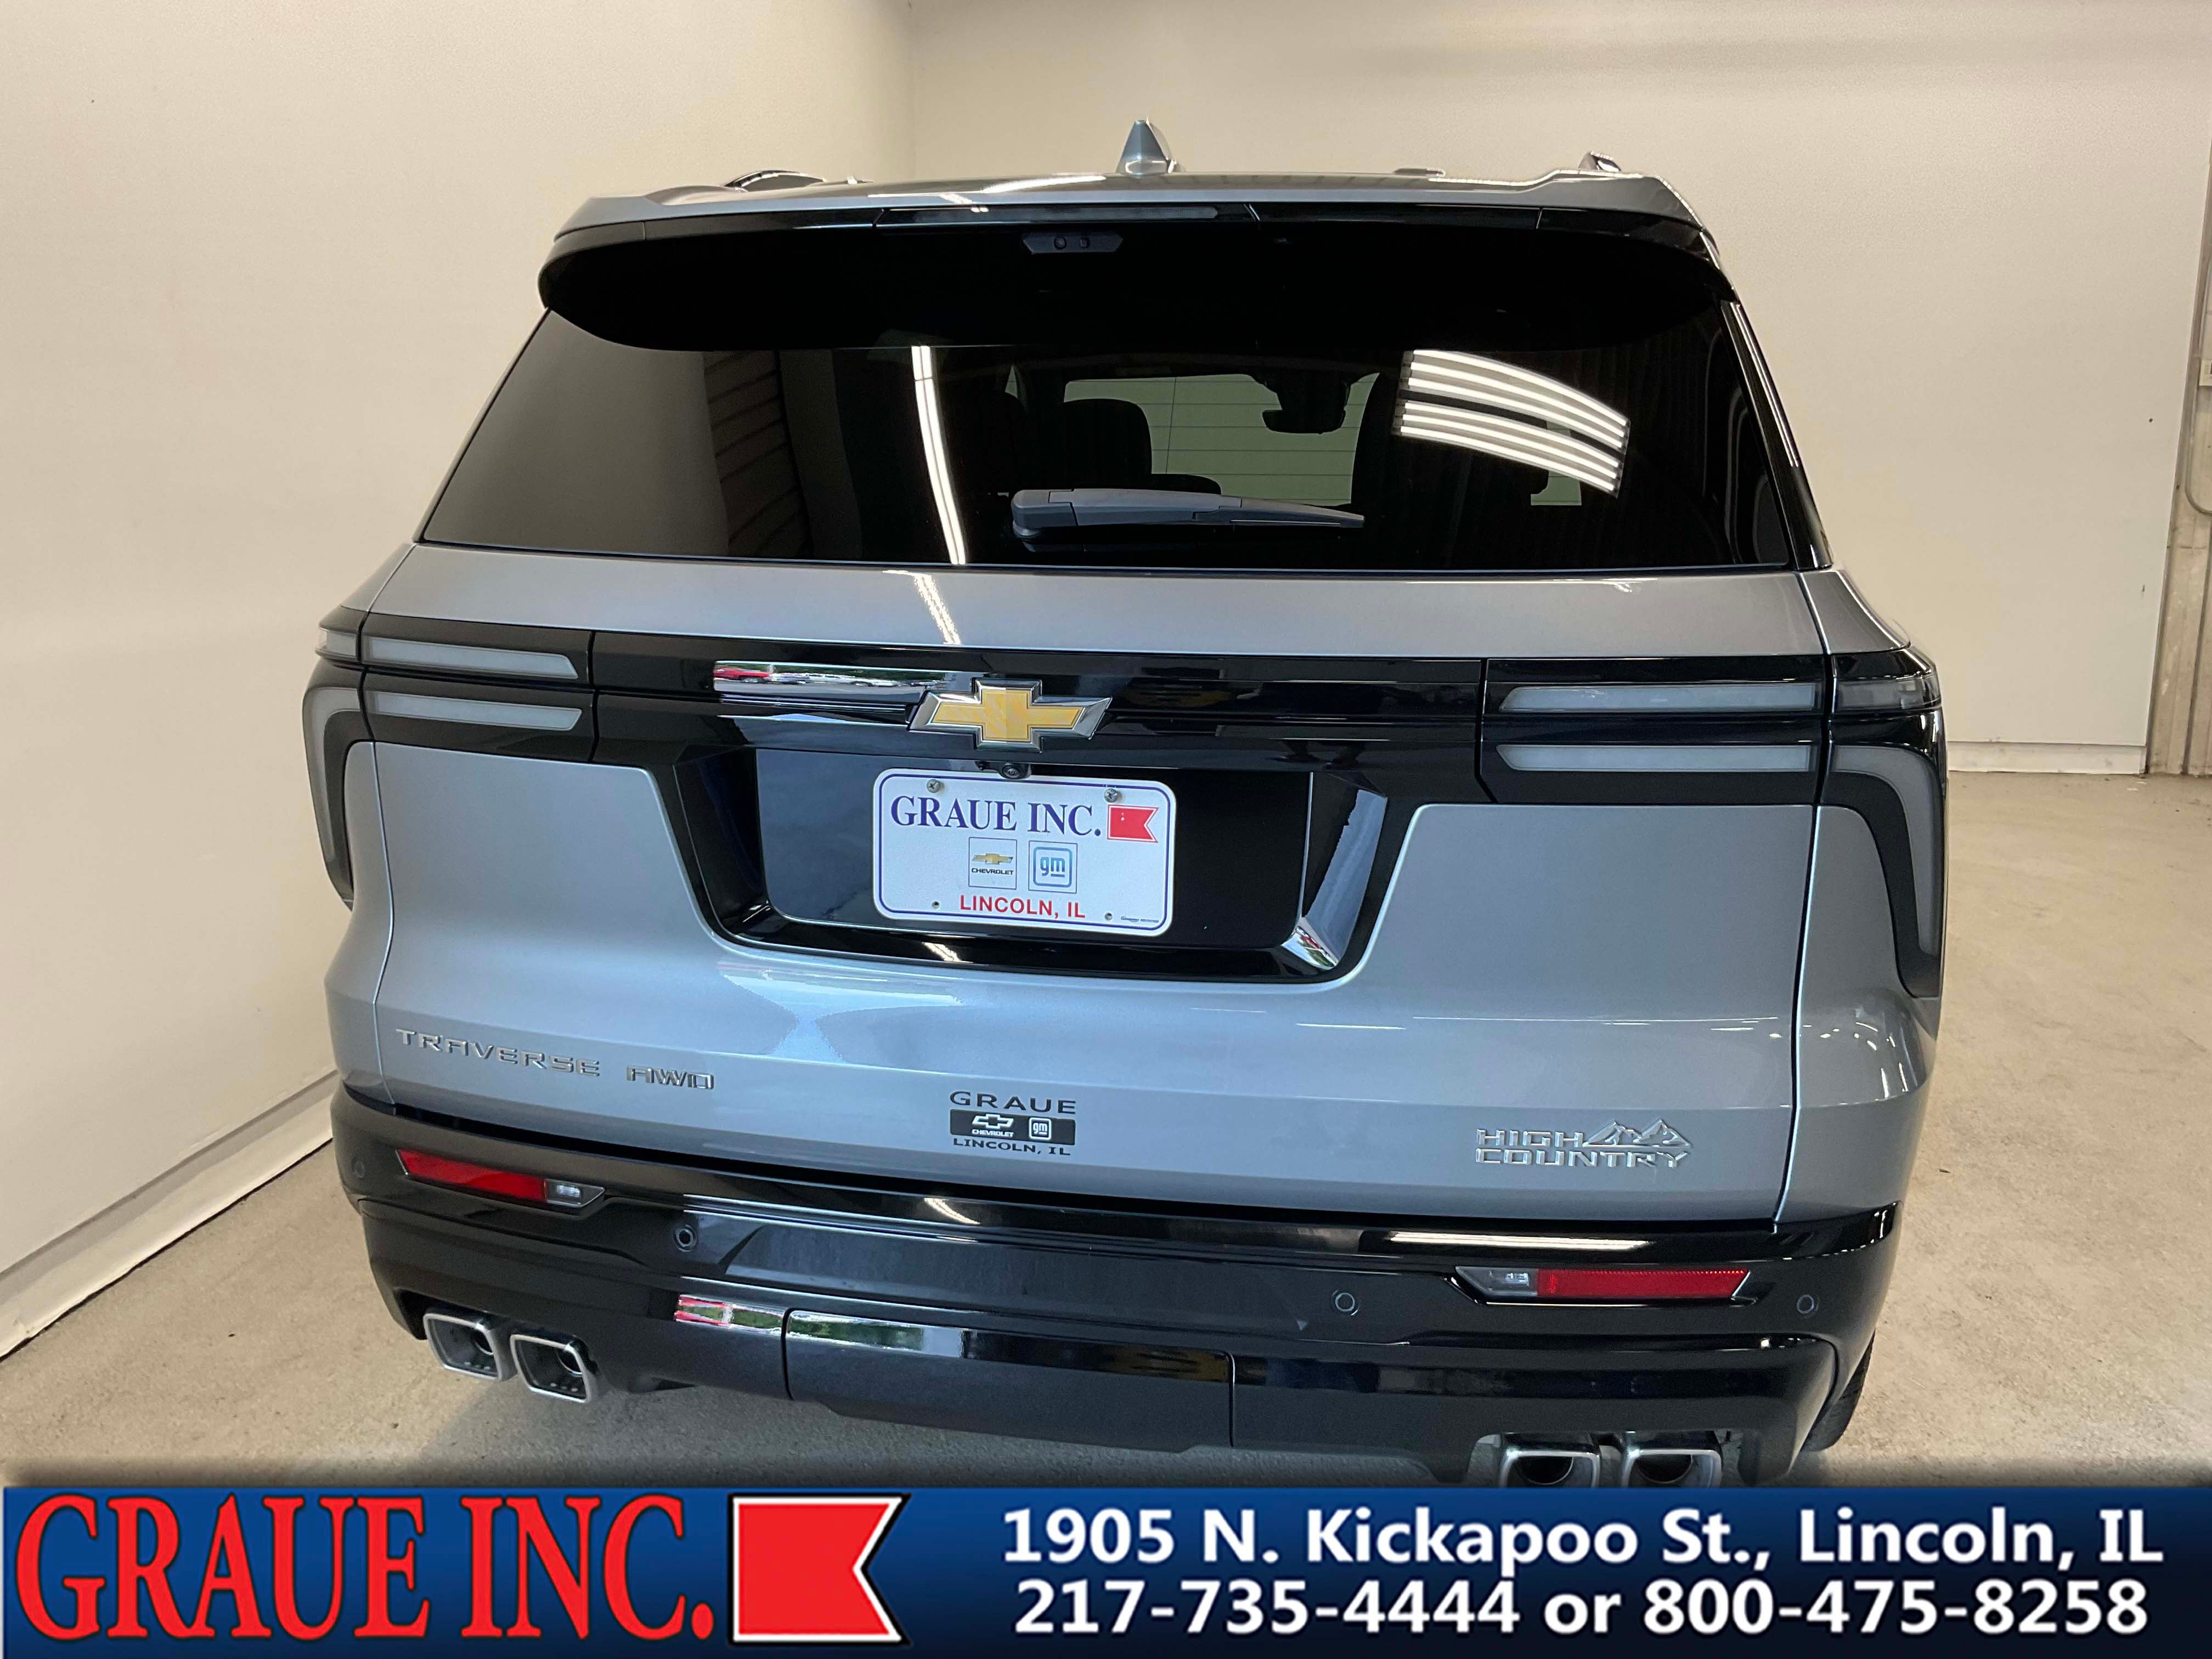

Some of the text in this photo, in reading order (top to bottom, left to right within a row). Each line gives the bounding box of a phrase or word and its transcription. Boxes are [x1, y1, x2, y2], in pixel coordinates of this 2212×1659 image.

[890, 795, 1102, 837] GRAUE INC.
[971, 867, 1014, 876] CHEVROLET
[1040, 856, 1066, 878] gm
[960, 894, 1086, 919] LINCOLN, IL
[396, 1028, 714, 1090] TRAVERSE AWD
[949, 1091, 1076, 1114] GRAUE
[971, 1128, 1014, 1137] CHEVROLET
[1032, 1122, 1048, 1135] gm
[1476, 1128, 1584, 1148] HIGH
[953, 1138, 1071, 1156] LINCOLN, IL
[1476, 1148, 1689, 1169] COUNTRY
